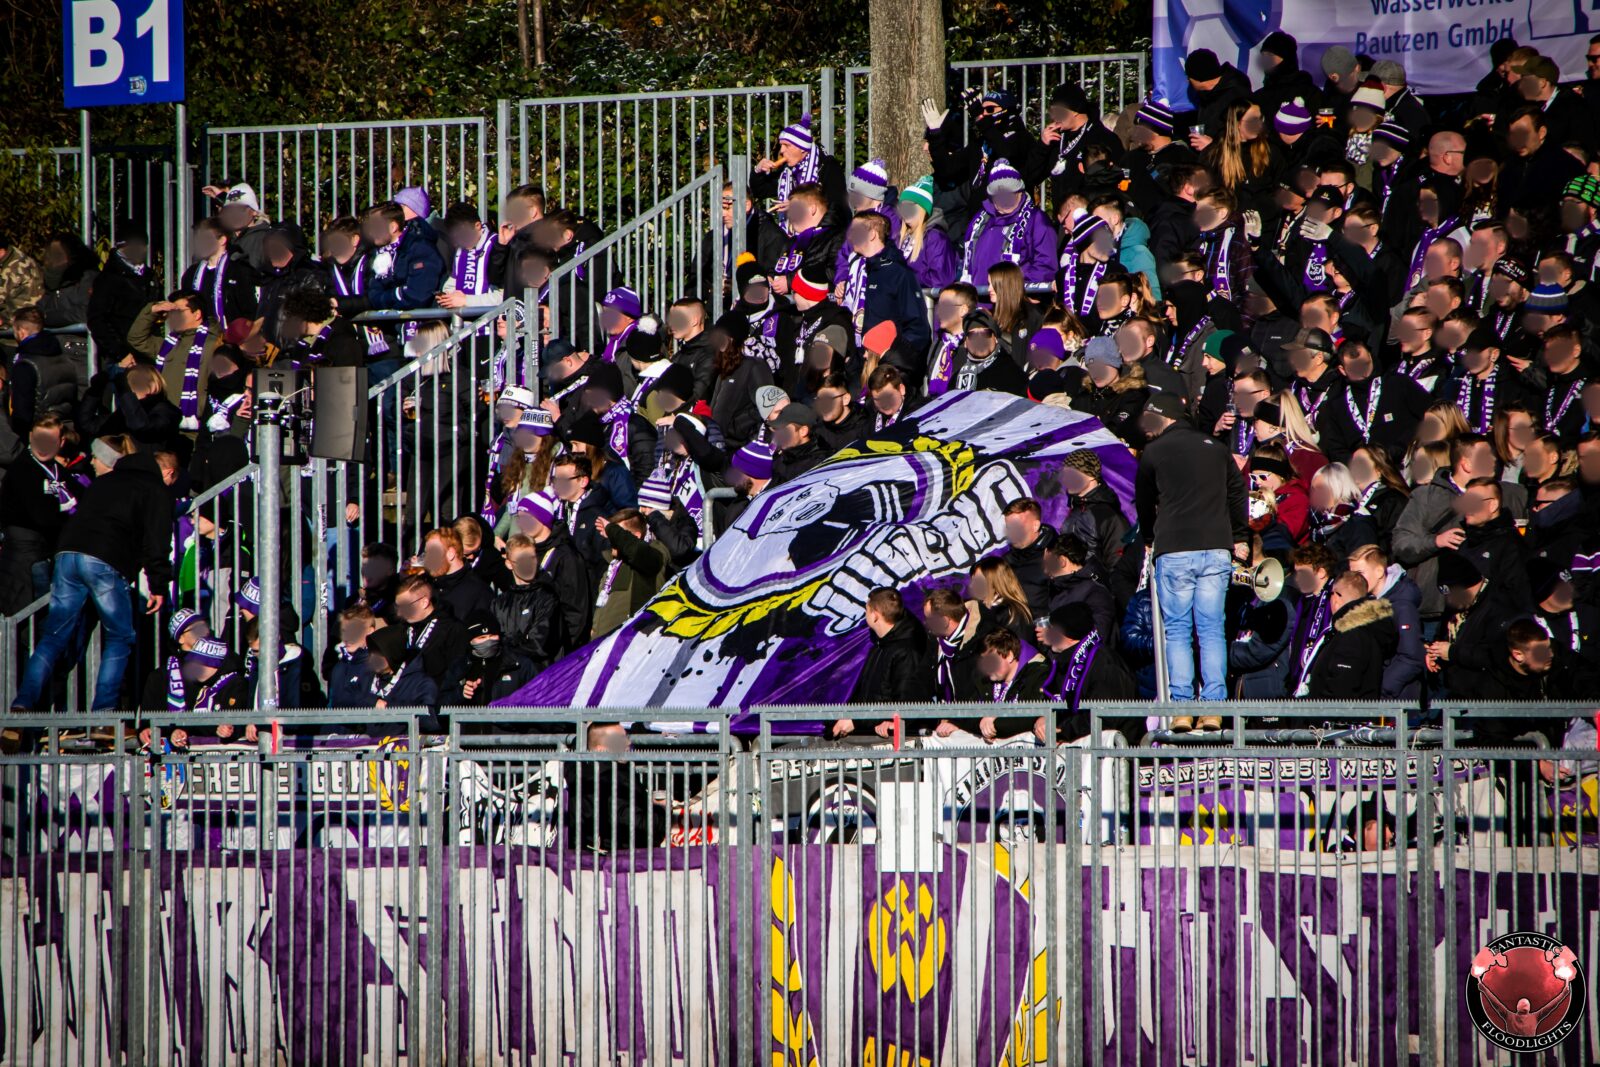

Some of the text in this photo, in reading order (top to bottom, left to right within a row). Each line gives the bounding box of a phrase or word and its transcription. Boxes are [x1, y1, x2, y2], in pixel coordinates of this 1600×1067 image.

[72, 0, 169, 87] B1
[1355, 18, 1514, 55] Bautzen GmbH
[1139, 758, 1273, 786] FANSZENE
[1279, 758, 1331, 780] BSG
